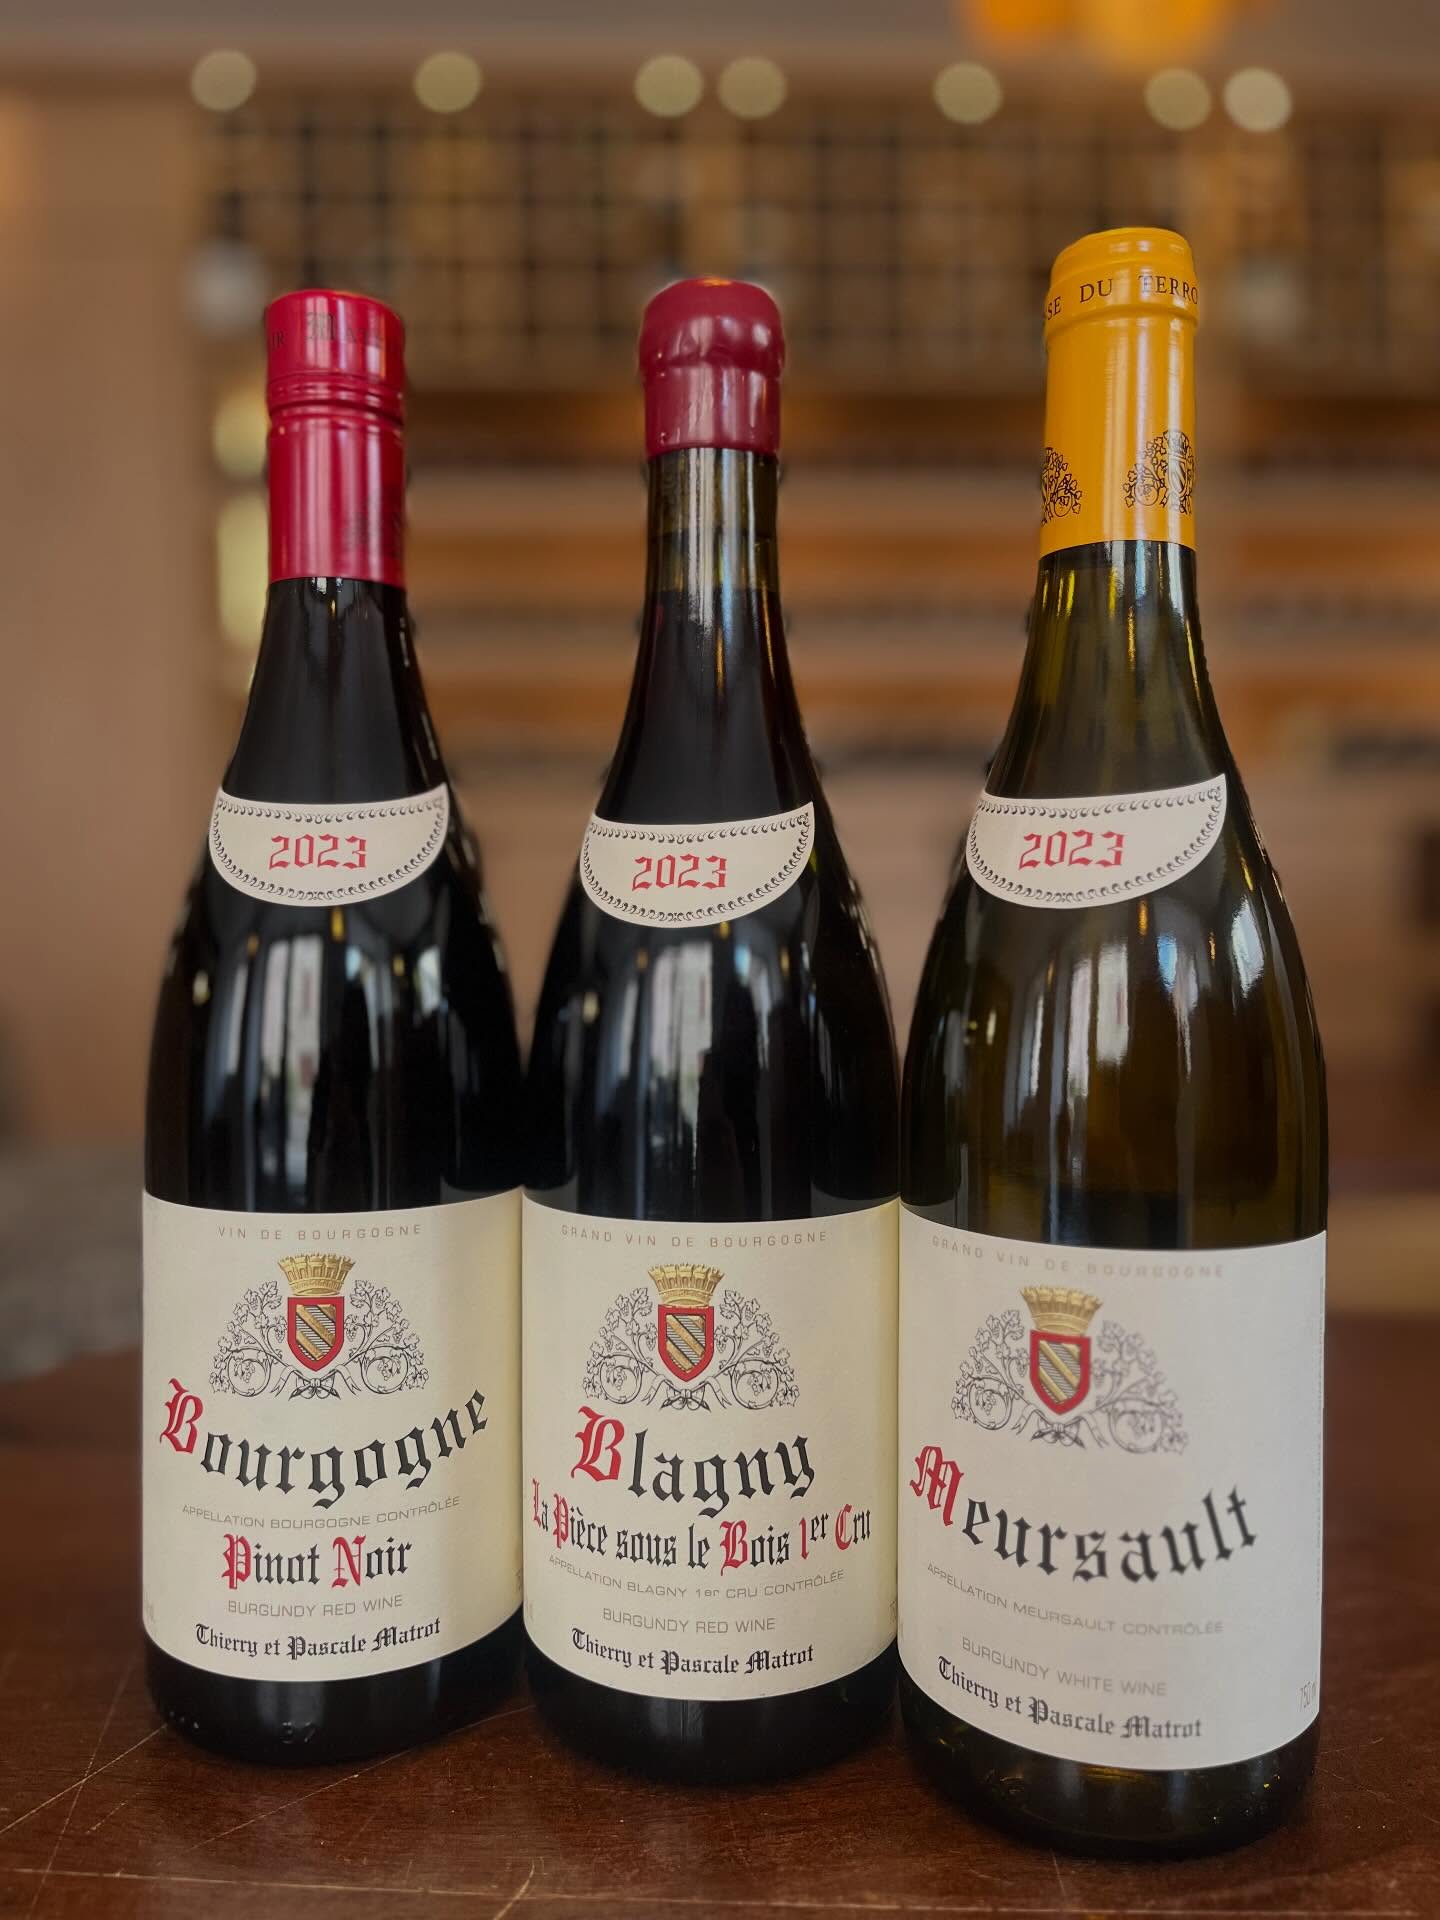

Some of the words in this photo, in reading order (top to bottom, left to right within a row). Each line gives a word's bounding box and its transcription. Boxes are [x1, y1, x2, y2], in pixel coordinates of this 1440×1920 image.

[1079, 278, 1113, 304] DU
[268, 833, 368, 871] 2023
[1018, 829, 1128, 871] 2023
[631, 853, 729, 892] 2023
[218, 1226, 247, 1240] VIN
[261, 1229, 282, 1240] DE
[298, 1224, 421, 1241] BOURGOGNE
[561, 1223, 612, 1243] GRAND
[625, 1233, 656, 1247] VIN
[672, 1236, 694, 1248] DE
[709, 1231, 827, 1248] BOURGOGNE
[932, 1235, 983, 1259] GRAND
[996, 1251, 1030, 1267] VIN
[1044, 1260, 1069, 1272] DE
[1087, 1264, 1225, 1278] BOURGOGNE
[159, 1378, 488, 1510] Bourgogne
[570, 1406, 815, 1518] Blagny
[182, 1504, 265, 1529] APPELLATION
[270, 1515, 371, 1530] BOURGOGNE
[376, 1496, 461, 1523] CONTRÔLÉE
[532, 1478, 549, 1532] La
[552, 1492, 608, 1556] Pièce
[615, 1529, 678, 1568] sous
[687, 1522, 711, 1570] le
[719, 1518, 791, 1577] Bois
[834, 1503, 872, 1551] Cru
[909, 1445, 1257, 1584] Meursault
[221, 1533, 320, 1590] Pinot
[331, 1534, 412, 1588] Noir
[549, 1555, 623, 1591] APPELLATION
[627, 1581, 688, 1599] BLAGNY
[696, 1587, 720, 1599] 1er
[726, 1586, 758, 1600] CRU
[764, 1568, 845, 1597] CONTRÔLÉE
[228, 1600, 317, 1618] BURGUNDY
[323, 1602, 356, 1617] RED
[363, 1595, 403, 1613] WINE
[602, 1607, 689, 1633] BURGUNDY
[696, 1620, 728, 1634] RED
[736, 1617, 777, 1633] WINE
[927, 1562, 1008, 1609] APPELLATION
[1013, 1601, 1117, 1634] MEURSAULT
[1122, 1620, 1225, 1637] CONTRÔLÉE
[195, 1623, 258, 1658] Thierry
[264, 1638, 281, 1656] et
[286, 1635, 366, 1661] Pascale
[371, 1617, 441, 1652] Matrot
[571, 1627, 632, 1669] Thierry
[638, 1651, 654, 1670] et
[660, 1649, 739, 1676] Pascale
[744, 1643, 815, 1675] Matrot
[961, 1636, 1049, 1680] BURGUNDY
[1057, 1670, 1113, 1693] WHITE
[1120, 1679, 1168, 1697] WINE
[938, 1655, 999, 1709] Thierry
[1004, 1695, 1022, 1715] et
[1027, 1696, 1115, 1736] Pascale
[1120, 1715, 1203, 1740] Matrot
